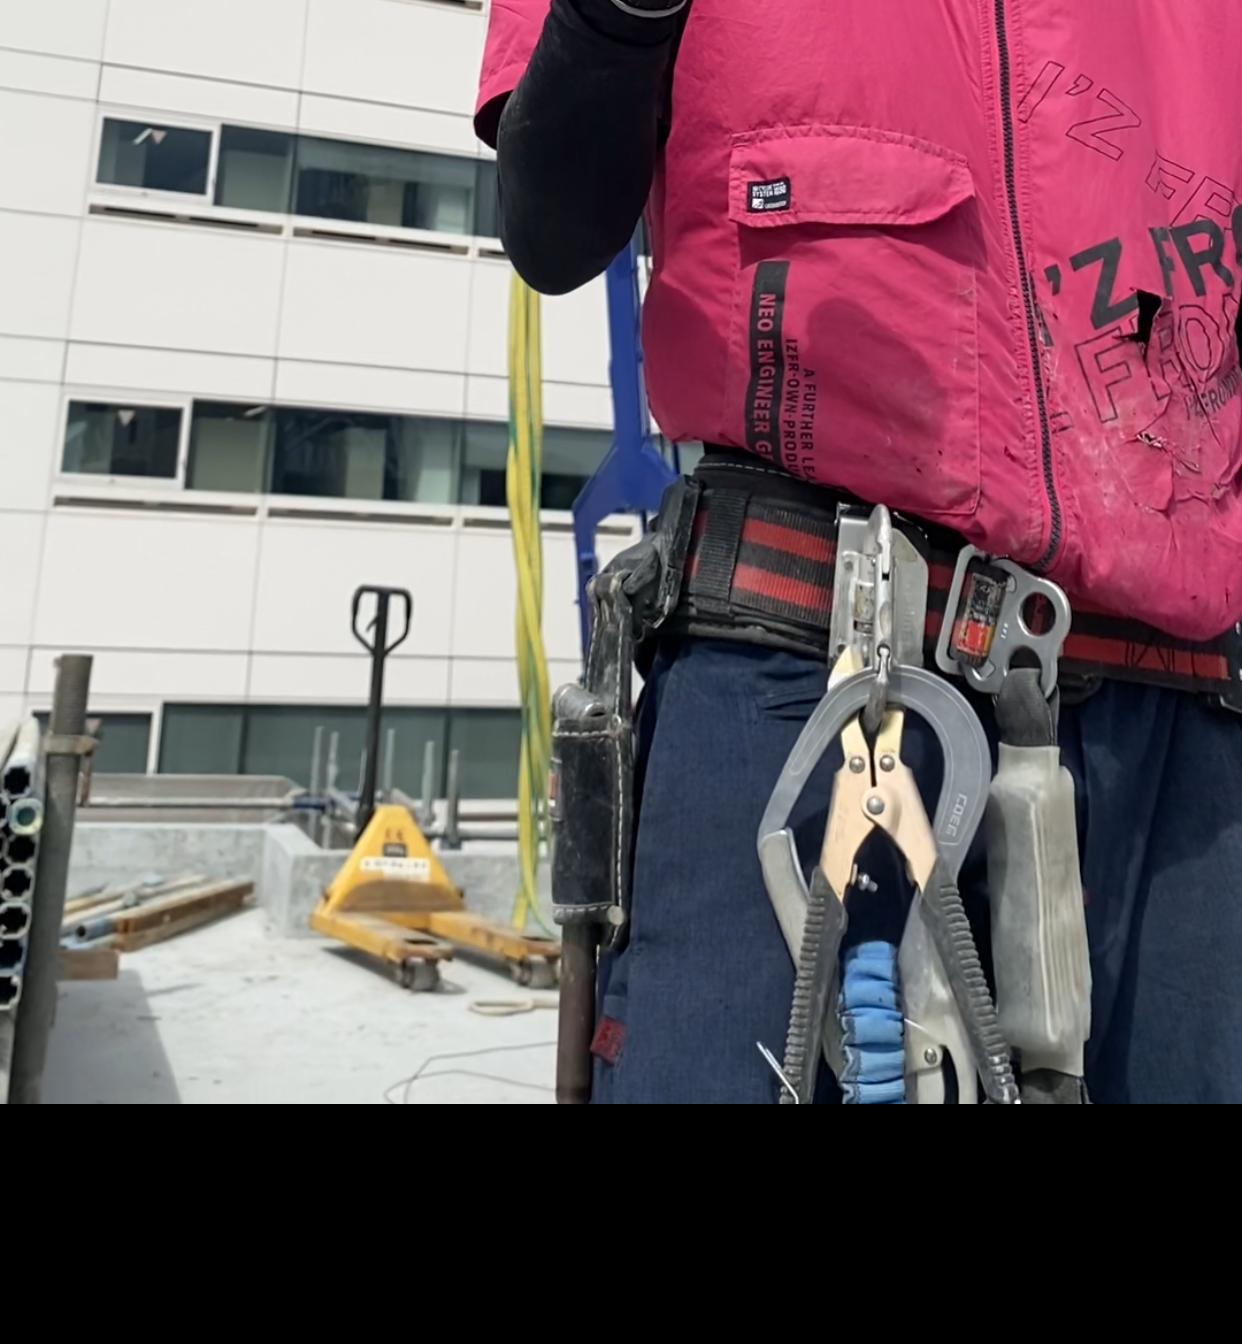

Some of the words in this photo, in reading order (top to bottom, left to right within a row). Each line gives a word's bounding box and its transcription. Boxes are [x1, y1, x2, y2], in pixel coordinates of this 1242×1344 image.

[757, 294, 776, 332] NEO
[753, 339, 776, 433] ENGINEER
[803, 368, 815, 378] A
[800, 384, 816, 450] FURTHER
